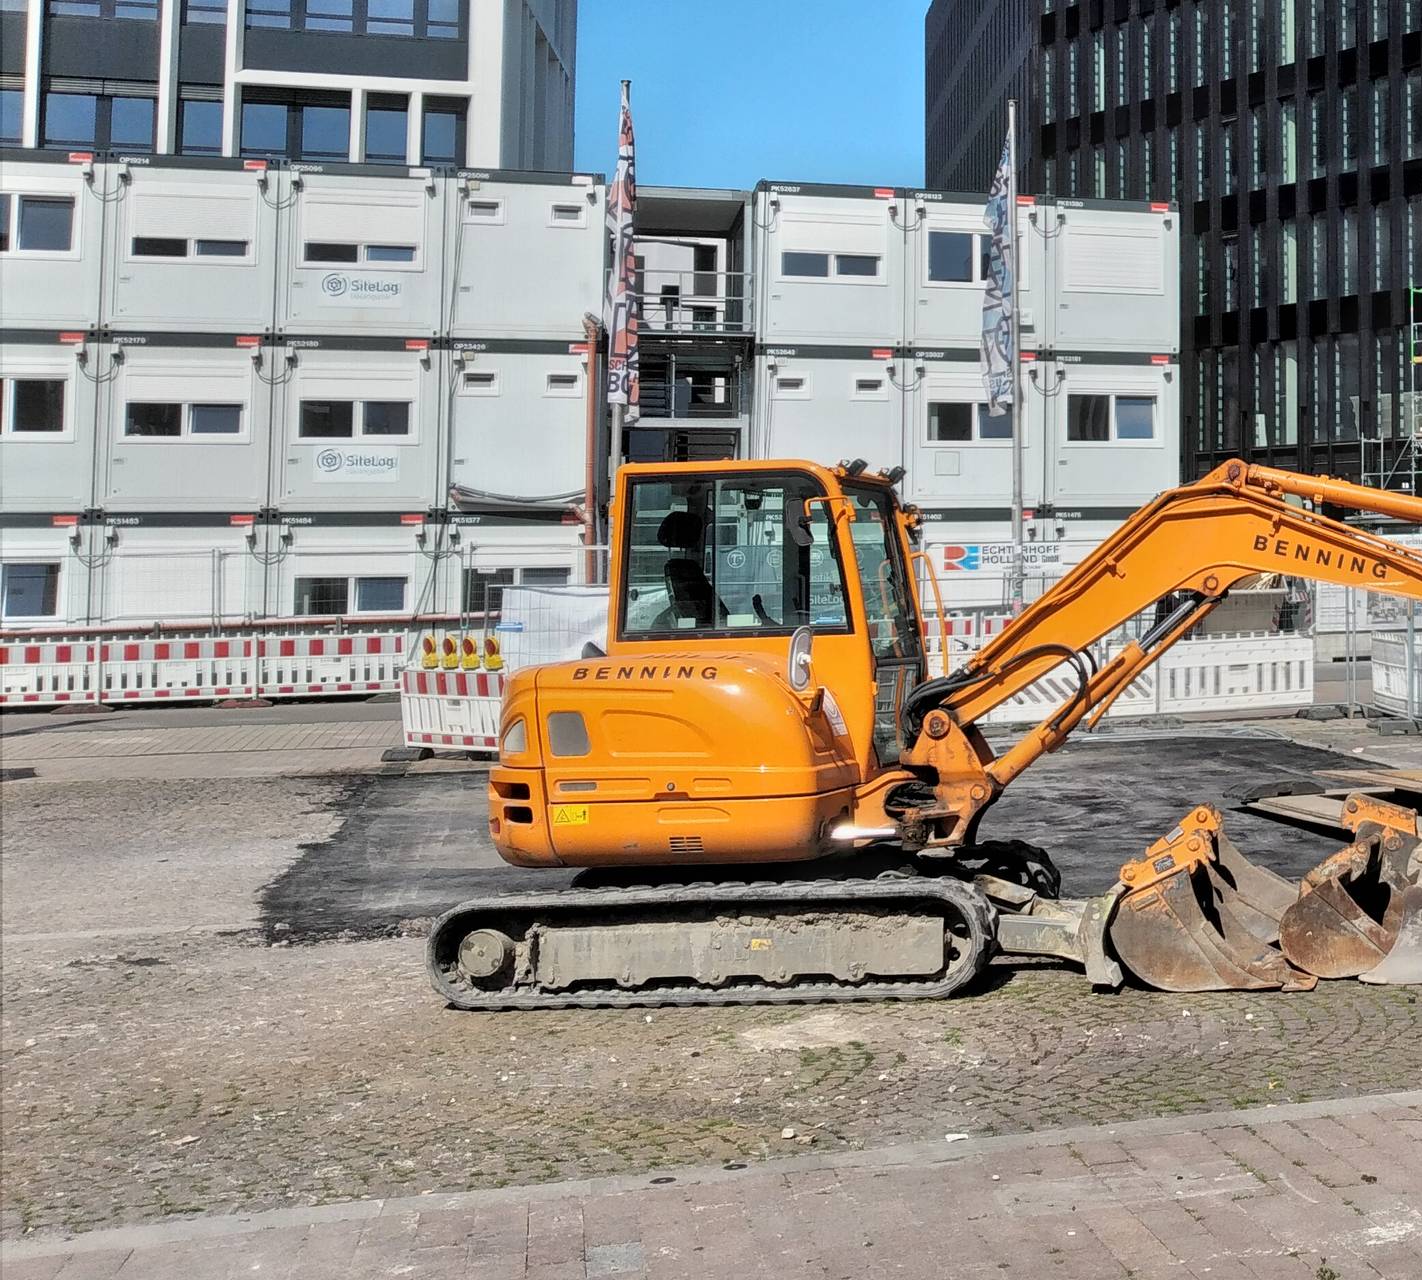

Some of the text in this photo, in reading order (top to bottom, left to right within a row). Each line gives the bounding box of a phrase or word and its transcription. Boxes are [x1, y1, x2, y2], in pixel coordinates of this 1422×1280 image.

[351, 279, 399, 296] SiteLog
[346, 455, 395, 470] SiteLog
[981, 545, 1060, 556] ECHTRHOFF
[1253, 534, 1388, 580] BENNING
[981, 555, 1037, 565] HOLLND
[572, 666, 718, 681] BENNING
